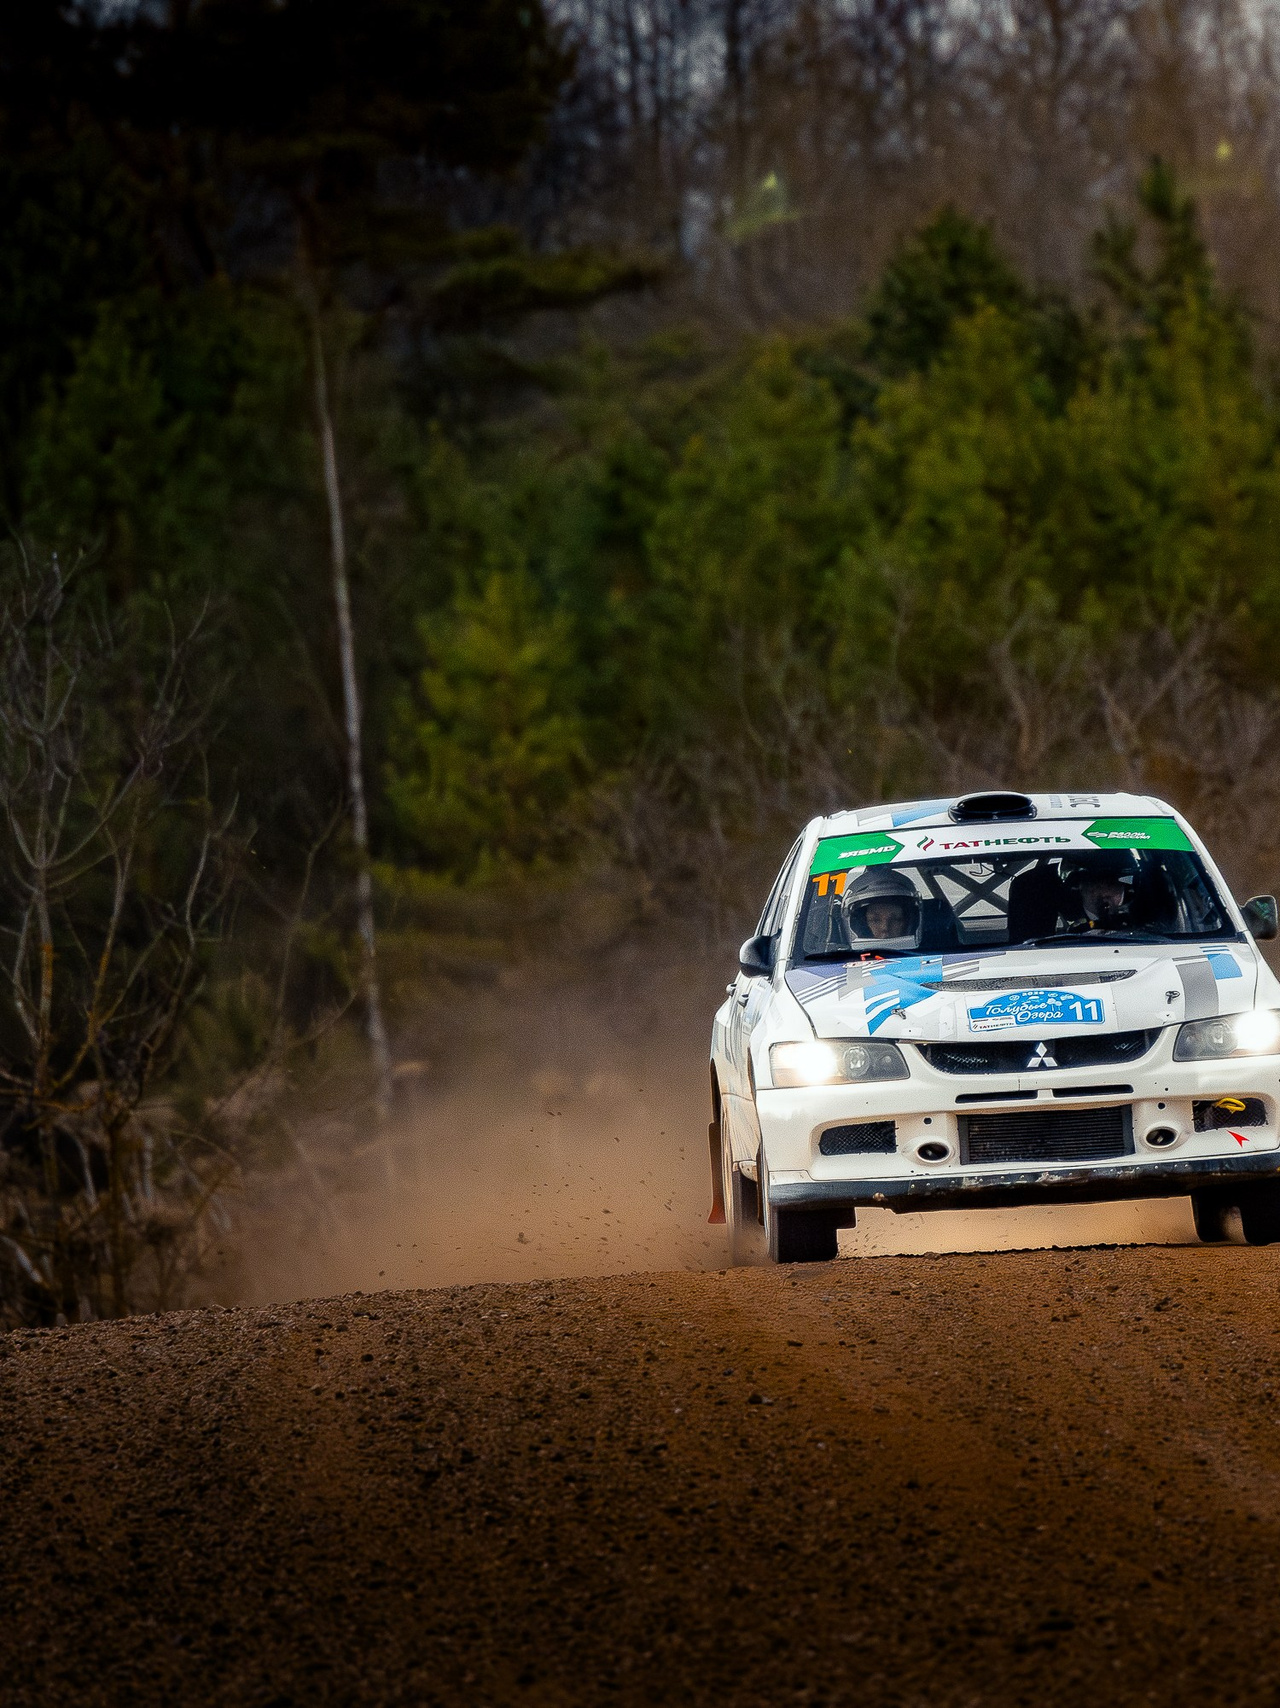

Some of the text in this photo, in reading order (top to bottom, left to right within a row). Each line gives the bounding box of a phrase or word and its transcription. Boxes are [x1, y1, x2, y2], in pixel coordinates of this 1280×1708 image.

[940, 836, 1071, 850] ТАТНЕФТЬ
[812, 872, 847, 897] 11
[1017, 1010, 1064, 1022] Озера
[1069, 1001, 1099, 1021] 11
